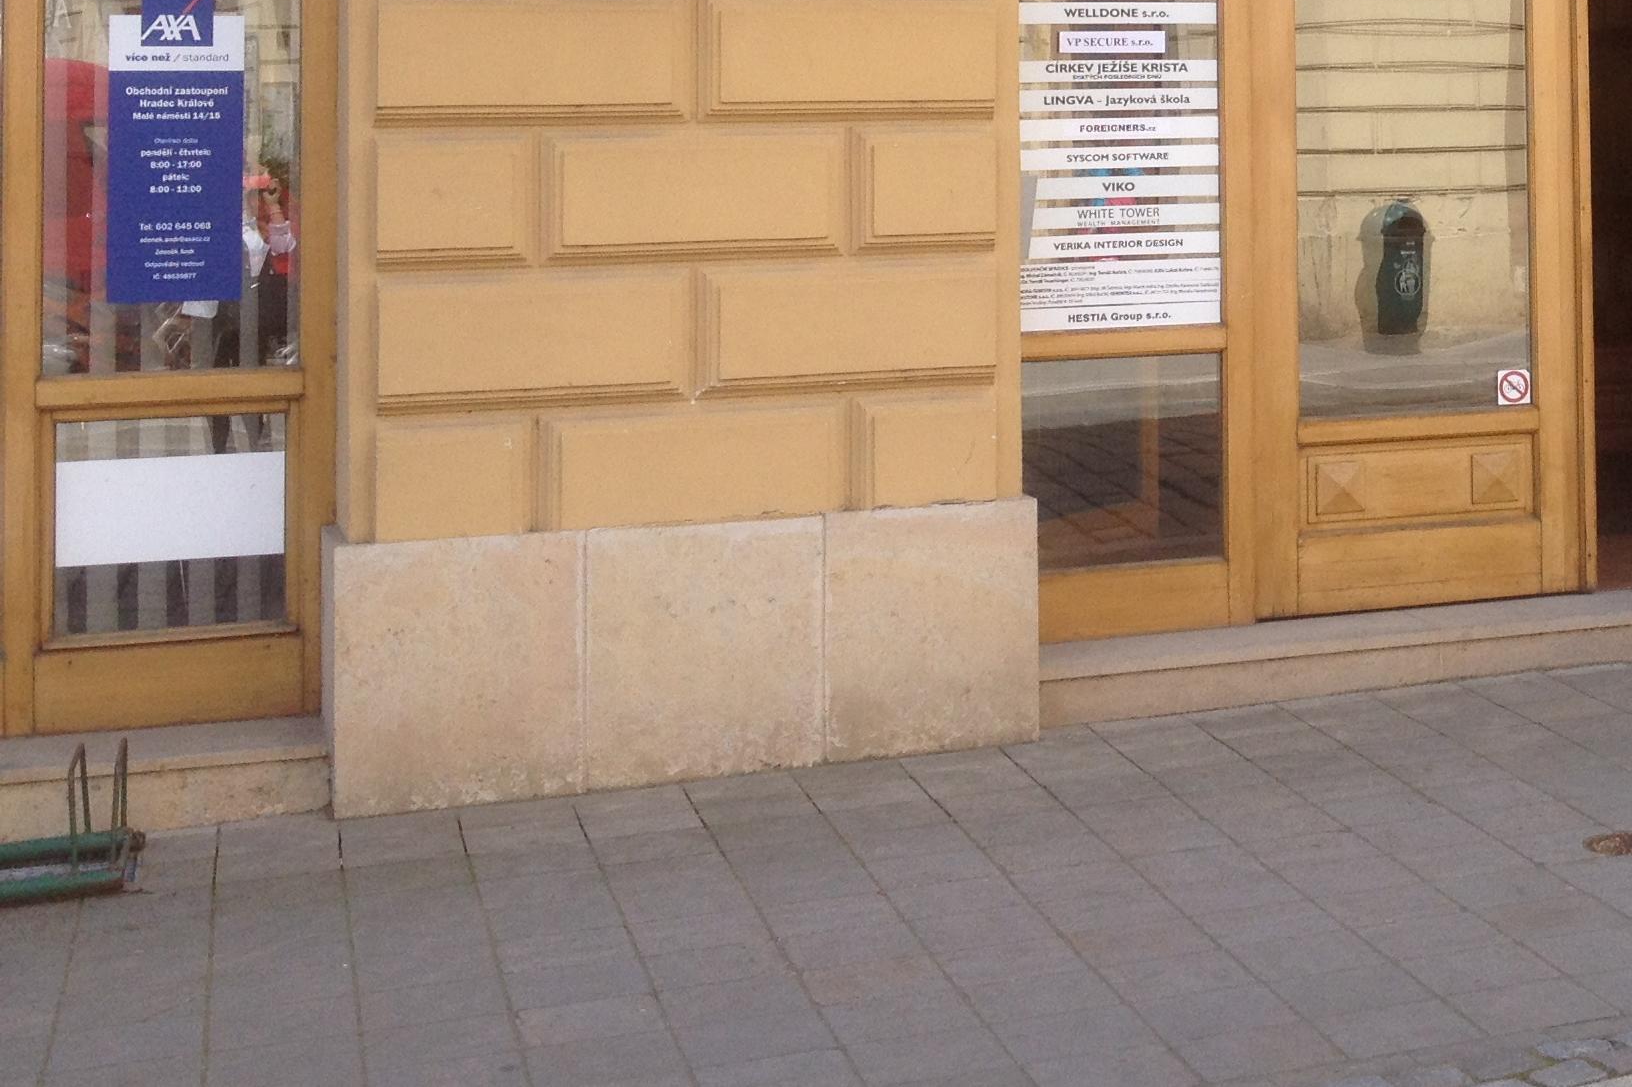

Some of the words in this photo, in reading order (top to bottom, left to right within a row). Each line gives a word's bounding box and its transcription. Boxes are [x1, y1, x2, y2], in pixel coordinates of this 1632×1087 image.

[1064, 8, 1139, 18] WELLDONE
[1142, 10, 1169, 18] s.r.o.
[141, 14, 201, 41] AXA
[1067, 37, 1081, 46] VP
[1083, 37, 1129, 47] SECURE
[125, 52, 148, 62] více
[152, 52, 171, 62] než
[183, 53, 229, 62] standard
[1046, 62, 1094, 73] CÍRKEV
[1097, 61, 1138, 74] JEŽÍŠE
[1142, 62, 1188, 72] KRISTA
[126, 86, 173, 95] Obchodní
[175, 86, 228, 97] zastoupení
[140, 99, 175, 107] Hradec
[177, 99, 214, 107] Králové
[1044, 95, 1094, 106] LINGVA
[1105, 94, 1157, 107] Jazyková
[1160, 93, 1190, 104] škola
[132, 112, 154, 120] Malé
[193, 112, 221, 120] 14/15
[1079, 124, 1156, 132] FOREIGNERS.cz
[140, 149, 173, 157] pondělí
[1066, 153, 1109, 162] SYSCOM
[1112, 152, 1169, 161] SOFTWARE
[150, 161, 170, 169] 8:00
[177, 160, 202, 168] 17:00
[1102, 182, 1135, 192] VIKO
[1077, 208, 1114, 219] WHITE
[1119, 207, 1160, 218] TOWER
[155, 223, 173, 231] 602
[1053, 242, 1091, 251] VERIKA
[1094, 240, 1143, 249] INTERIOR
[1146, 238, 1183, 247] DESIGN
[1068, 313, 1107, 323] HESTIA
[1110, 312, 1143, 322] Group
